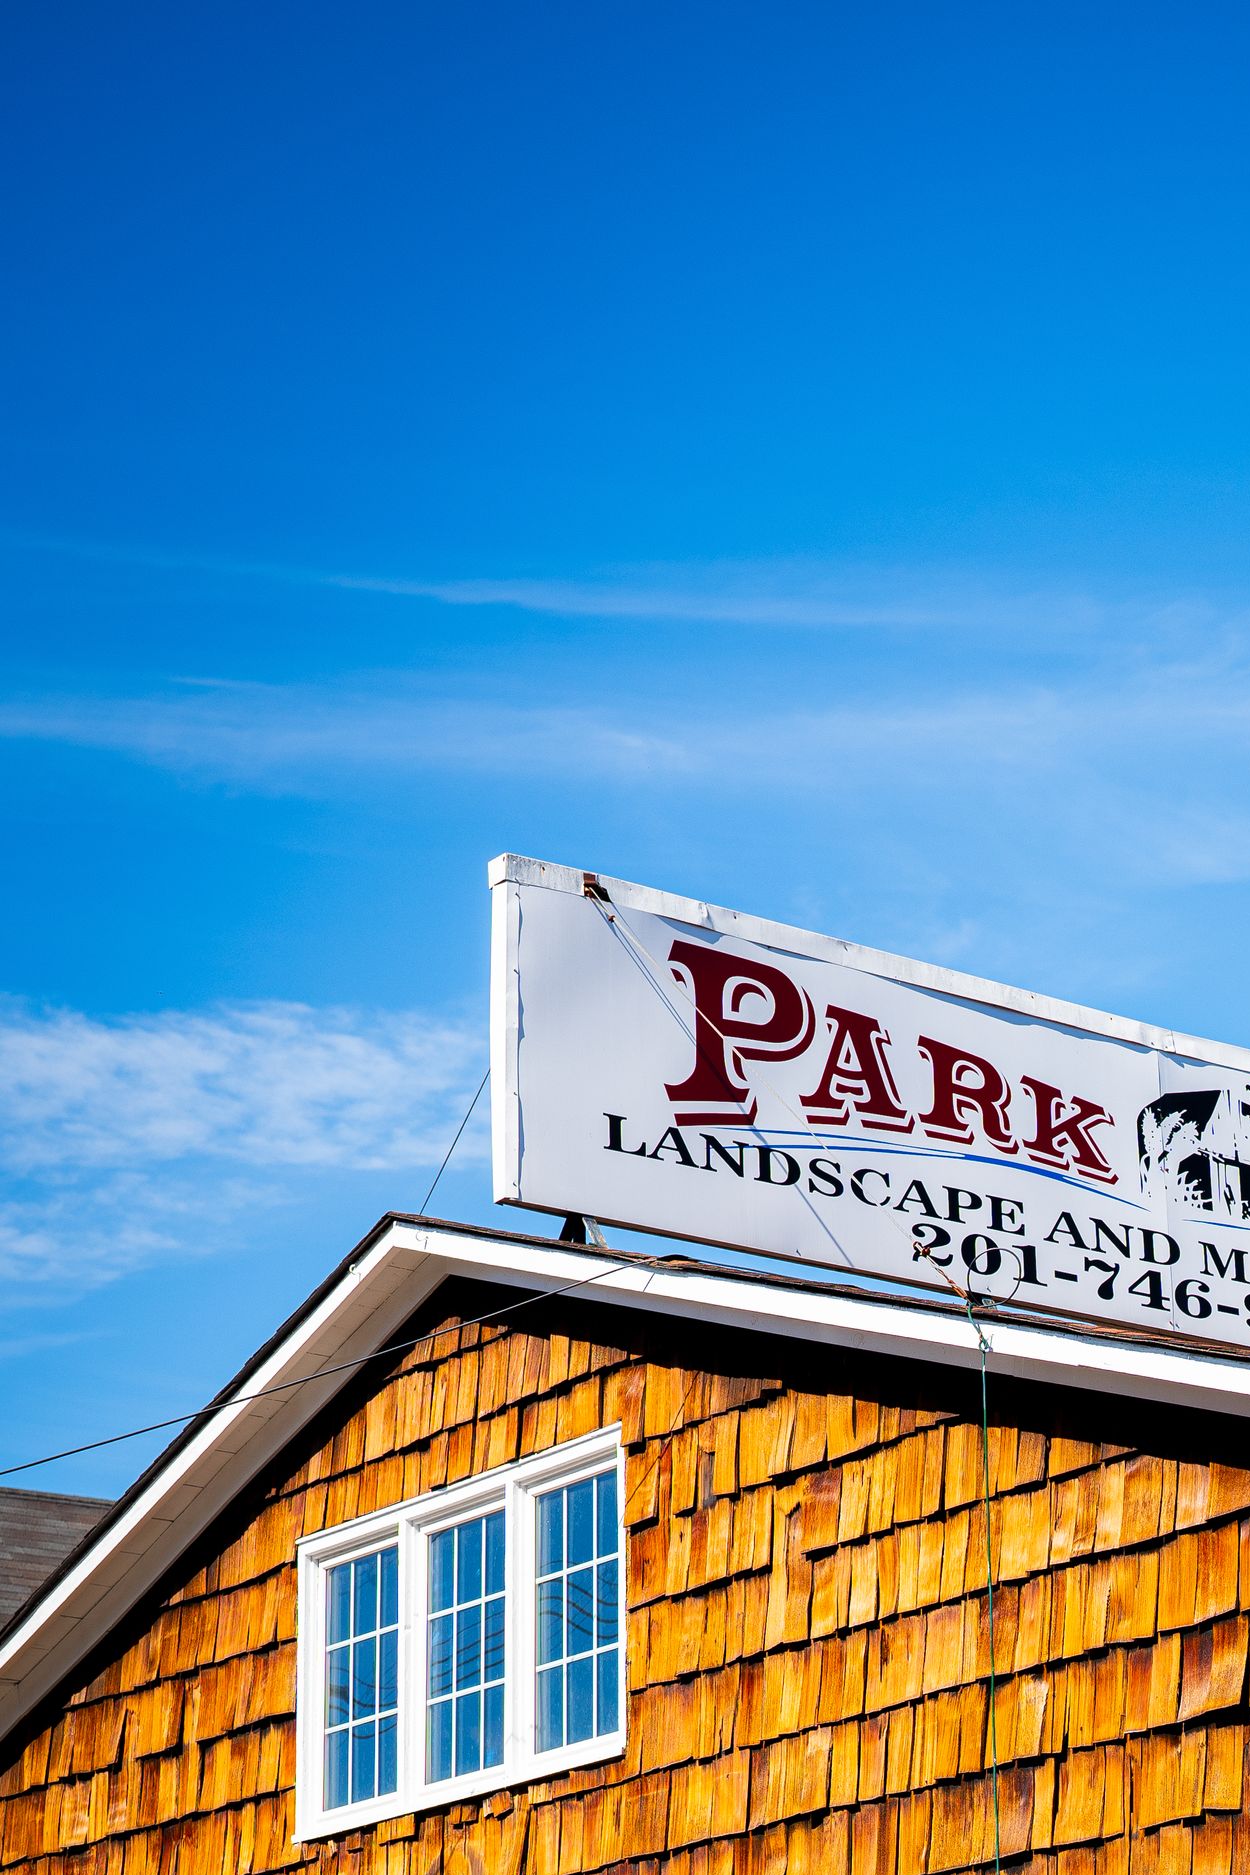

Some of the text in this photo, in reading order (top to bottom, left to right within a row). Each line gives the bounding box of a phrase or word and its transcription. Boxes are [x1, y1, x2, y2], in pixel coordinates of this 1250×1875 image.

[664, 940, 1119, 1185] PARK
[603, 1113, 1026, 1236] LANDSCAPE
[1042, 1210, 1182, 1266] AND
